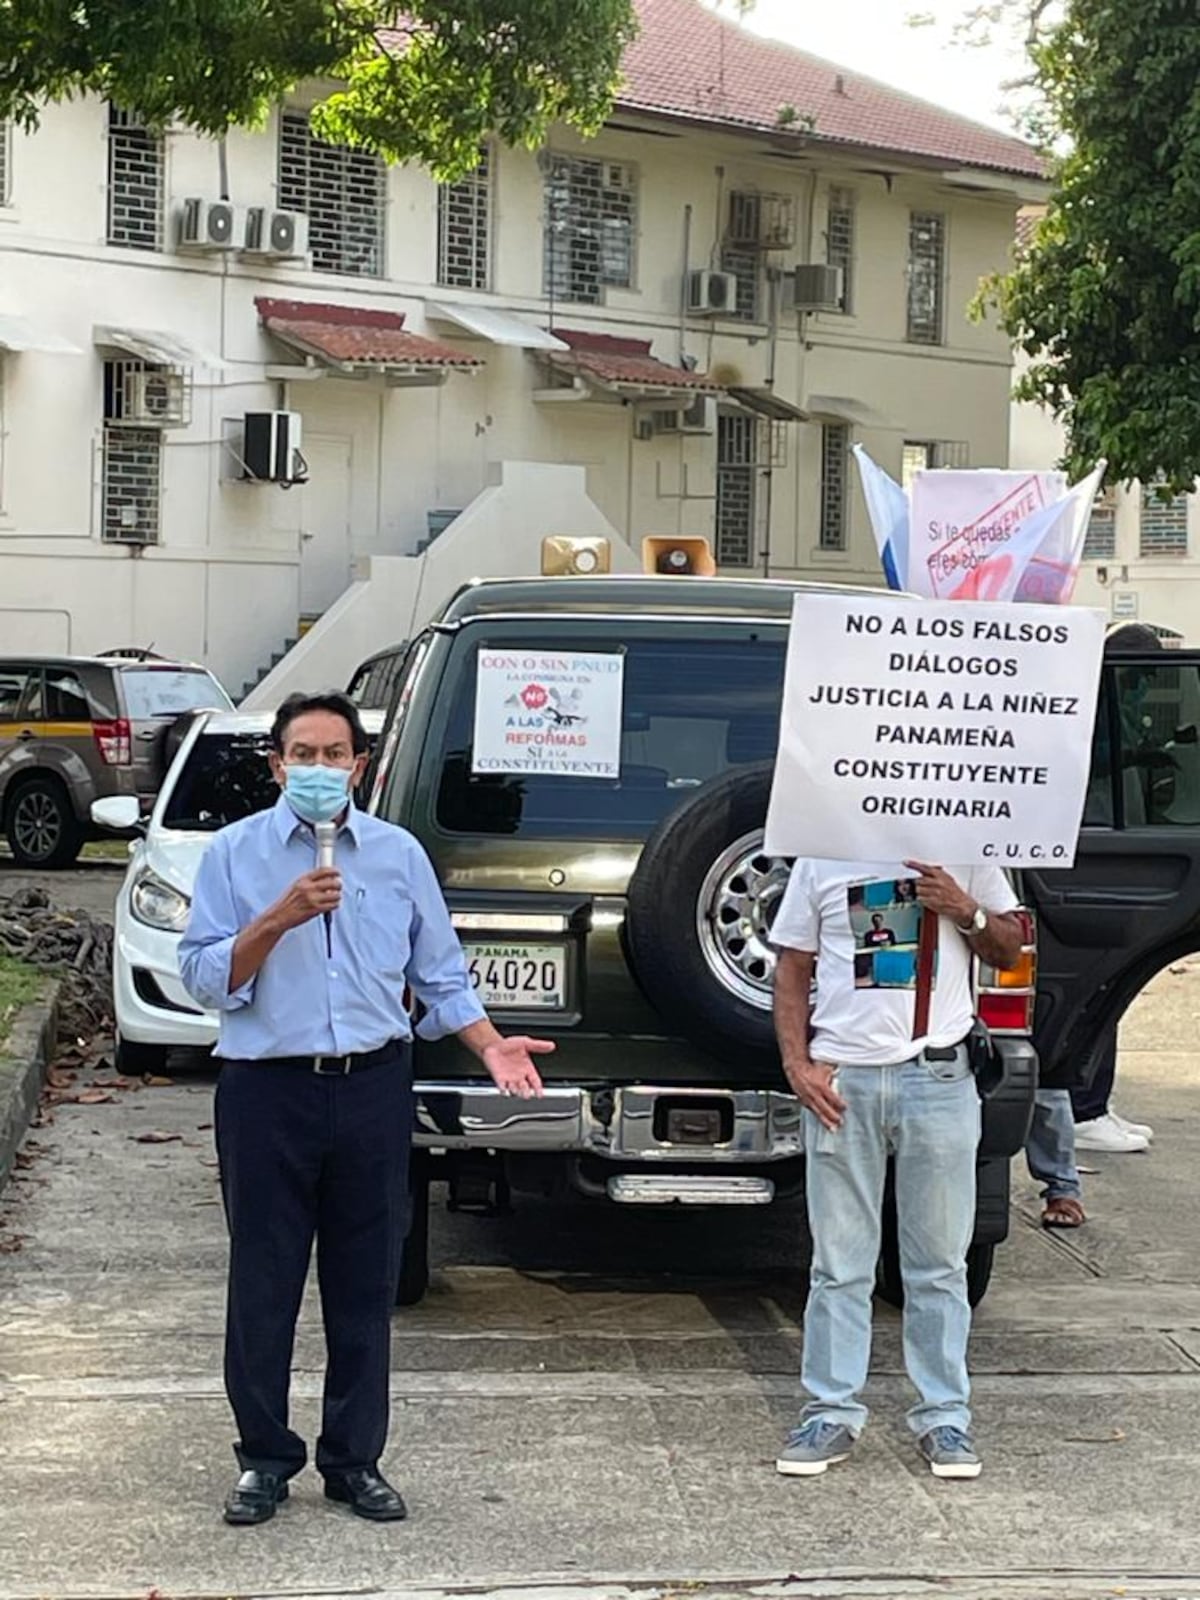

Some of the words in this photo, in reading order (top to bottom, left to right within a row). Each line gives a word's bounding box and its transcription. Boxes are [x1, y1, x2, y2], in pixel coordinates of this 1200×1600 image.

[846, 615, 883, 634] NO
[890, 617, 907, 635] A
[916, 618, 964, 638] LOS
[972, 621, 1069, 644] FALSOS
[481, 656, 518, 669] CON
[522, 658, 537, 670] O
[540, 659, 568, 671] SIN
[571, 661, 620, 673] PNUD
[889, 651, 1018, 677] DIÁLOGOS
[809, 685, 929, 709] JUSTICIA
[937, 691, 954, 710] A
[963, 692, 994, 712] LA
[1002, 692, 1079, 715] NIÑEZ
[506, 716, 515, 727] A
[518, 716, 544, 727] LAS
[505, 733, 587, 746] REFORMAS
[875, 724, 1016, 749] PANAMEÑA
[477, 758, 615, 774] CONSTITUYENTE
[833, 758, 1048, 785] CONSTITUYENTE
[861, 796, 1012, 819] ORIGINARIA
[475, 947, 529, 958] PANAMA
